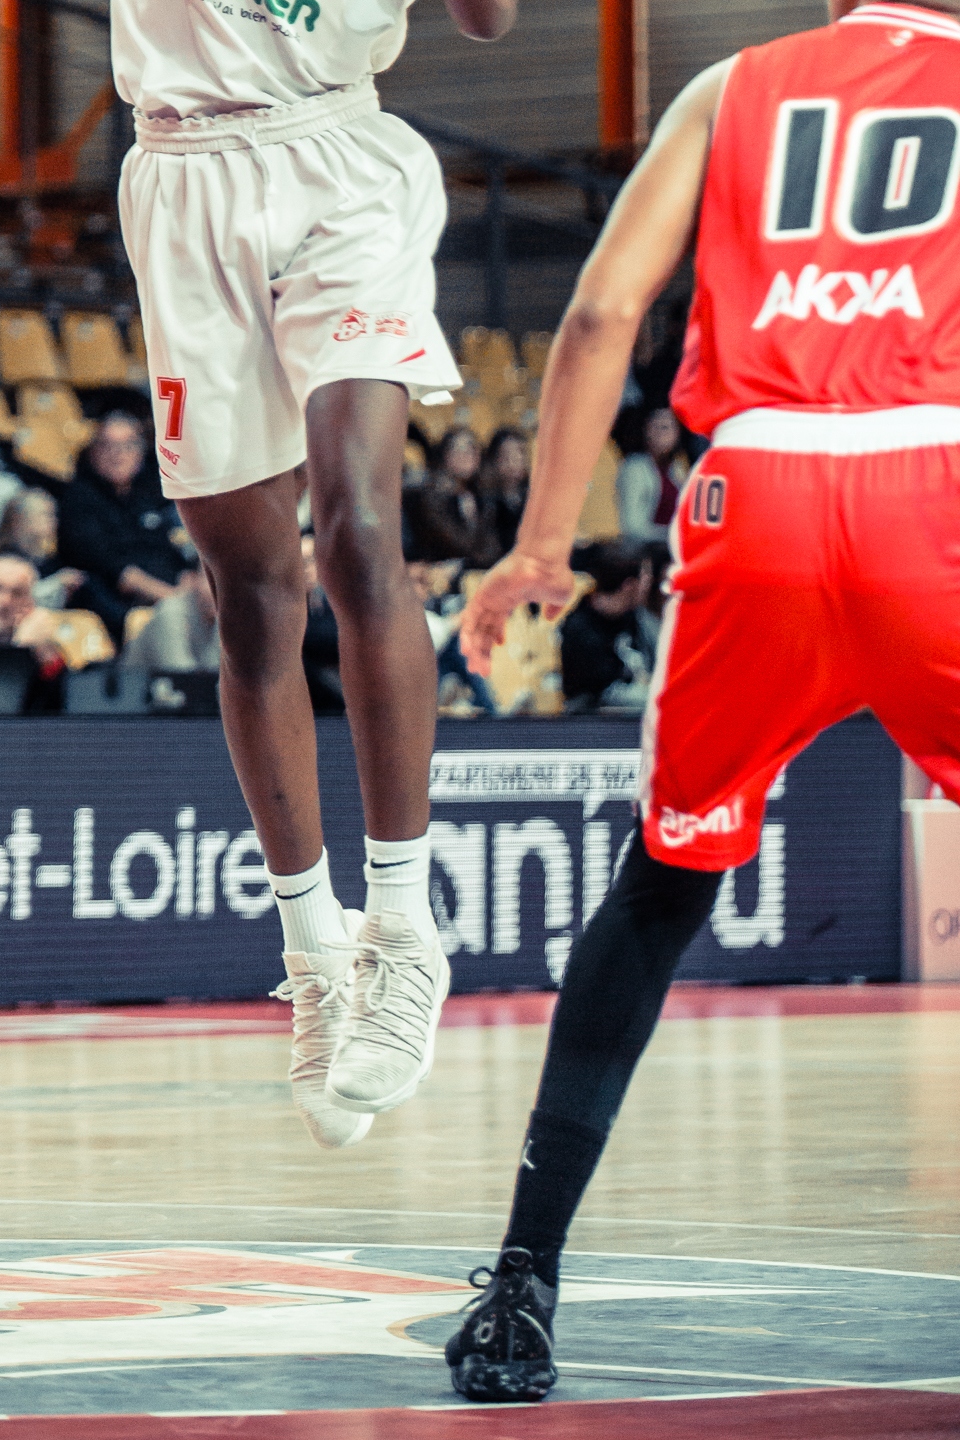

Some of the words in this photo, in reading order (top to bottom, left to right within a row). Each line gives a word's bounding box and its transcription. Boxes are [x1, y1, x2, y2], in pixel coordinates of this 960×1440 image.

[762, 97, 960, 244] 10
[157, 376, 187, 441] 7
[692, 474, 727, 528] 10
[428, 791, 786, 988] anju
